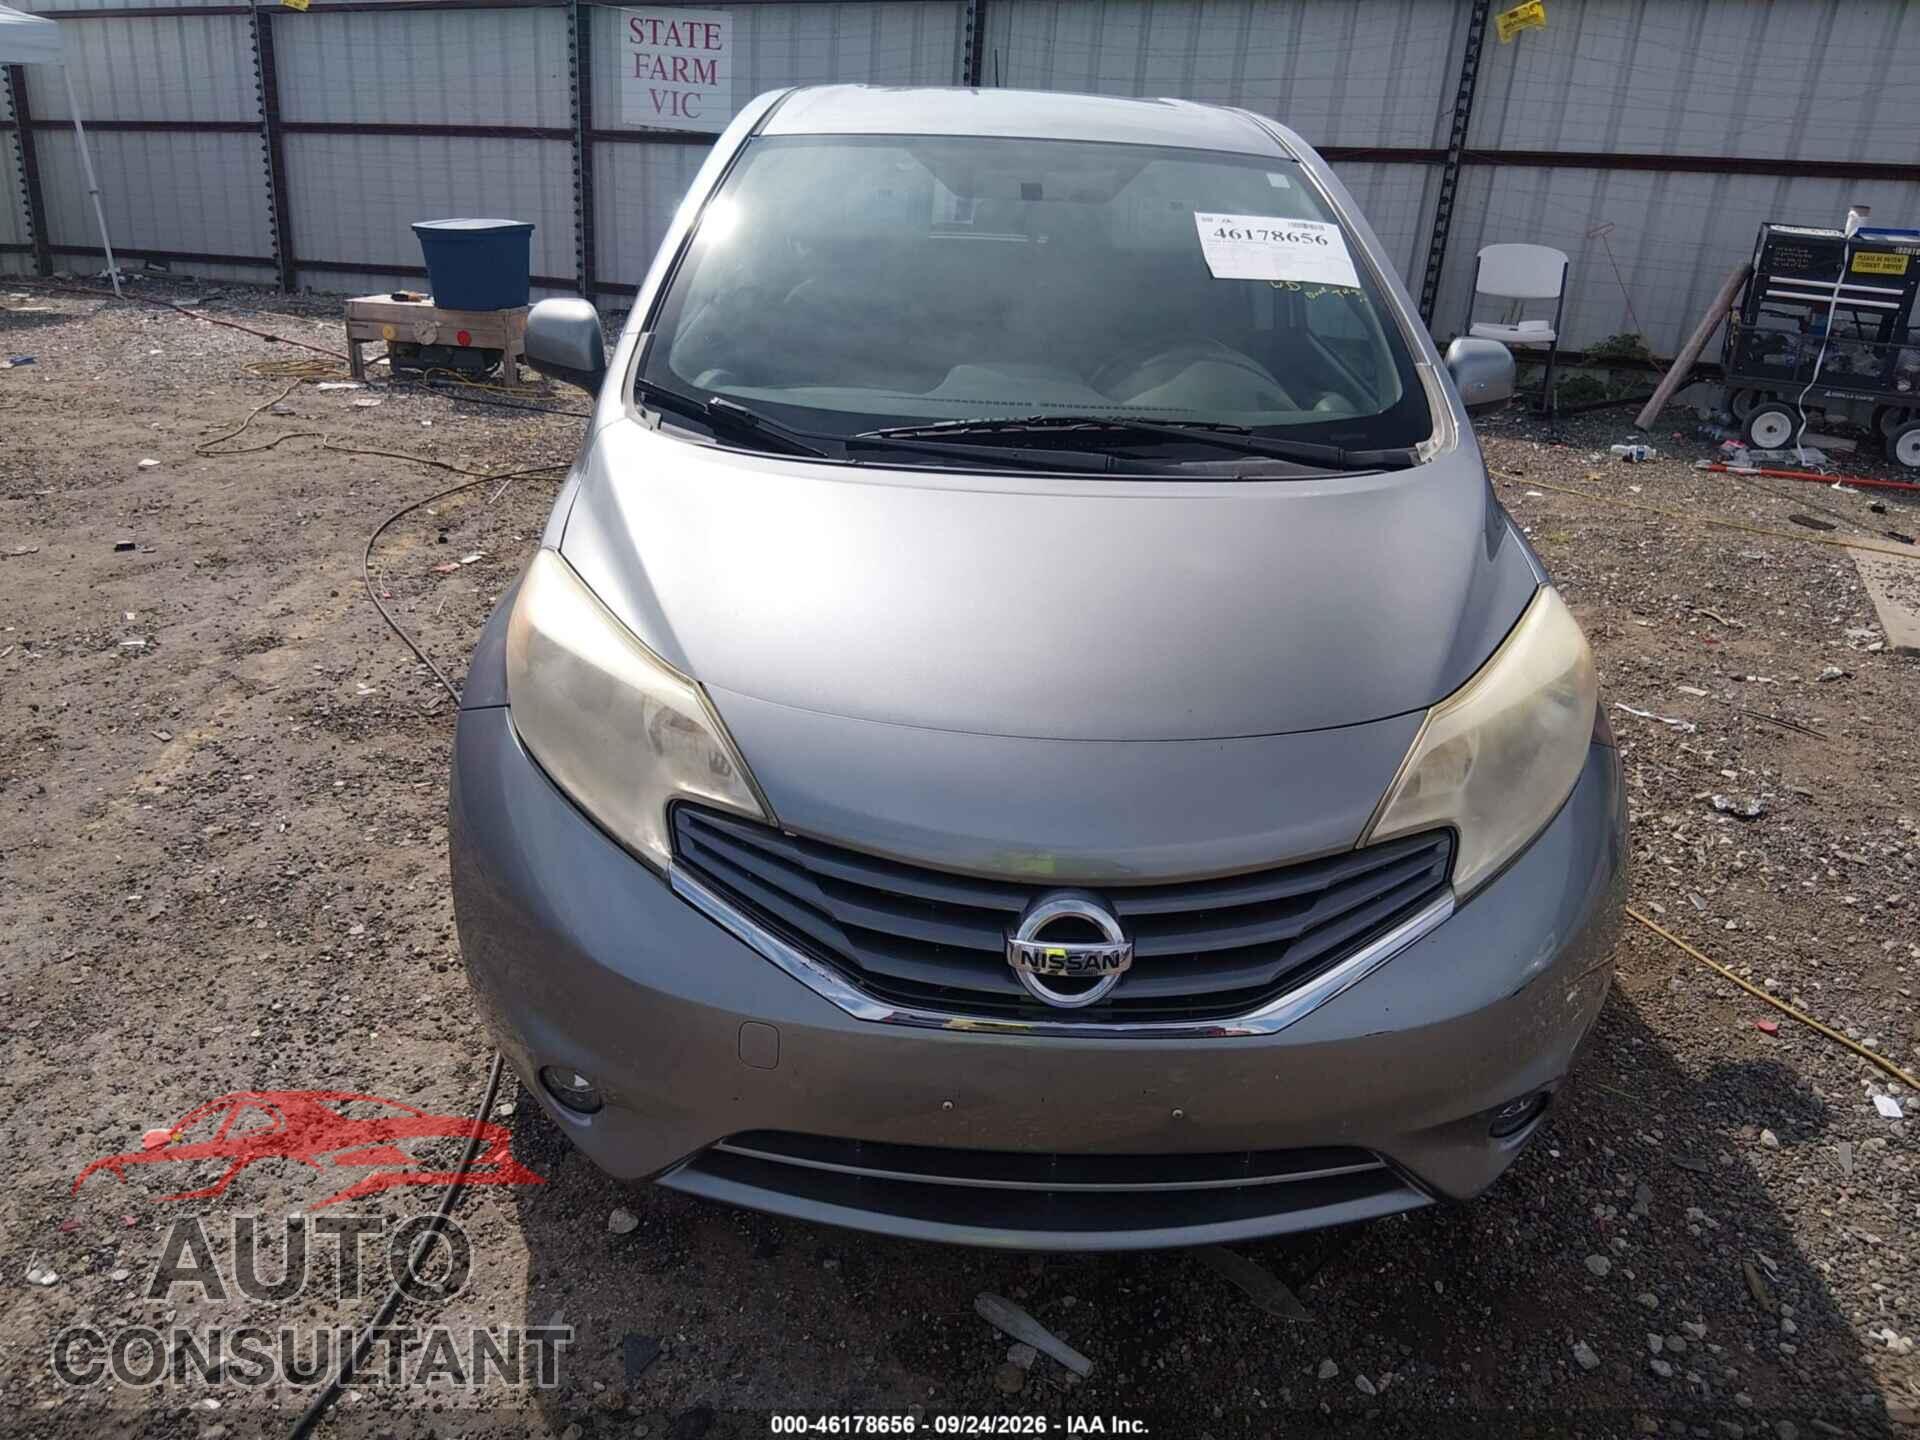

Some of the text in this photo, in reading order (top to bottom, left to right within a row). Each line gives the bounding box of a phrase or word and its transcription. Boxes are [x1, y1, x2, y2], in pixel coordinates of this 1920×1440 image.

[629, 17, 722, 51] STATE
[633, 53, 718, 86] FARM
[649, 88, 702, 119] VIC
[1213, 227, 1329, 247] 46178656
[1020, 950, 1120, 971] NISSAN
